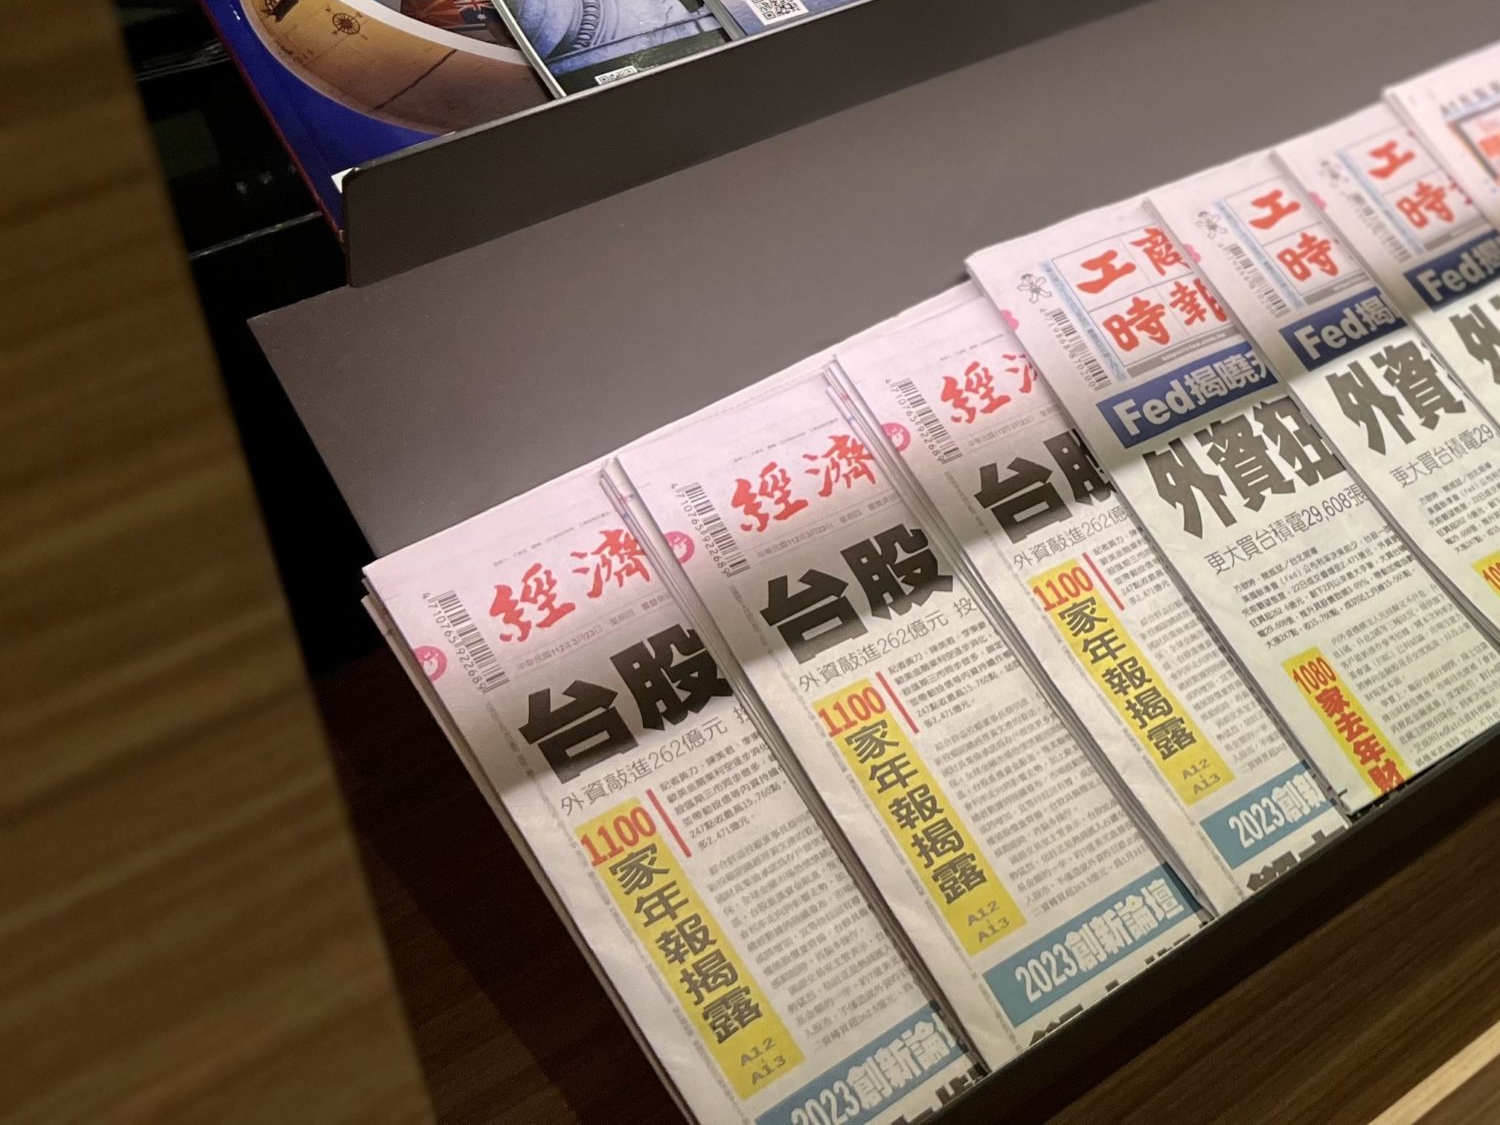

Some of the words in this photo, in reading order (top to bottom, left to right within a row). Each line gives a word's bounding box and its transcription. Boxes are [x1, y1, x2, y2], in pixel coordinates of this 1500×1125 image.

[1326, 341, 1466, 456] 外資
[731, 434, 876, 534] 經濟
[490, 529, 652, 642] 經濟
[759, 523, 953, 665] 台股
[518, 624, 733, 784] 台股
[799, 609, 948, 693] 外資敲進262億元
[561, 716, 728, 817] 外資敲進262億元
[1015, 877, 1184, 1003] 2023創新論壇
[791, 1010, 960, 1125] 2023創新論
